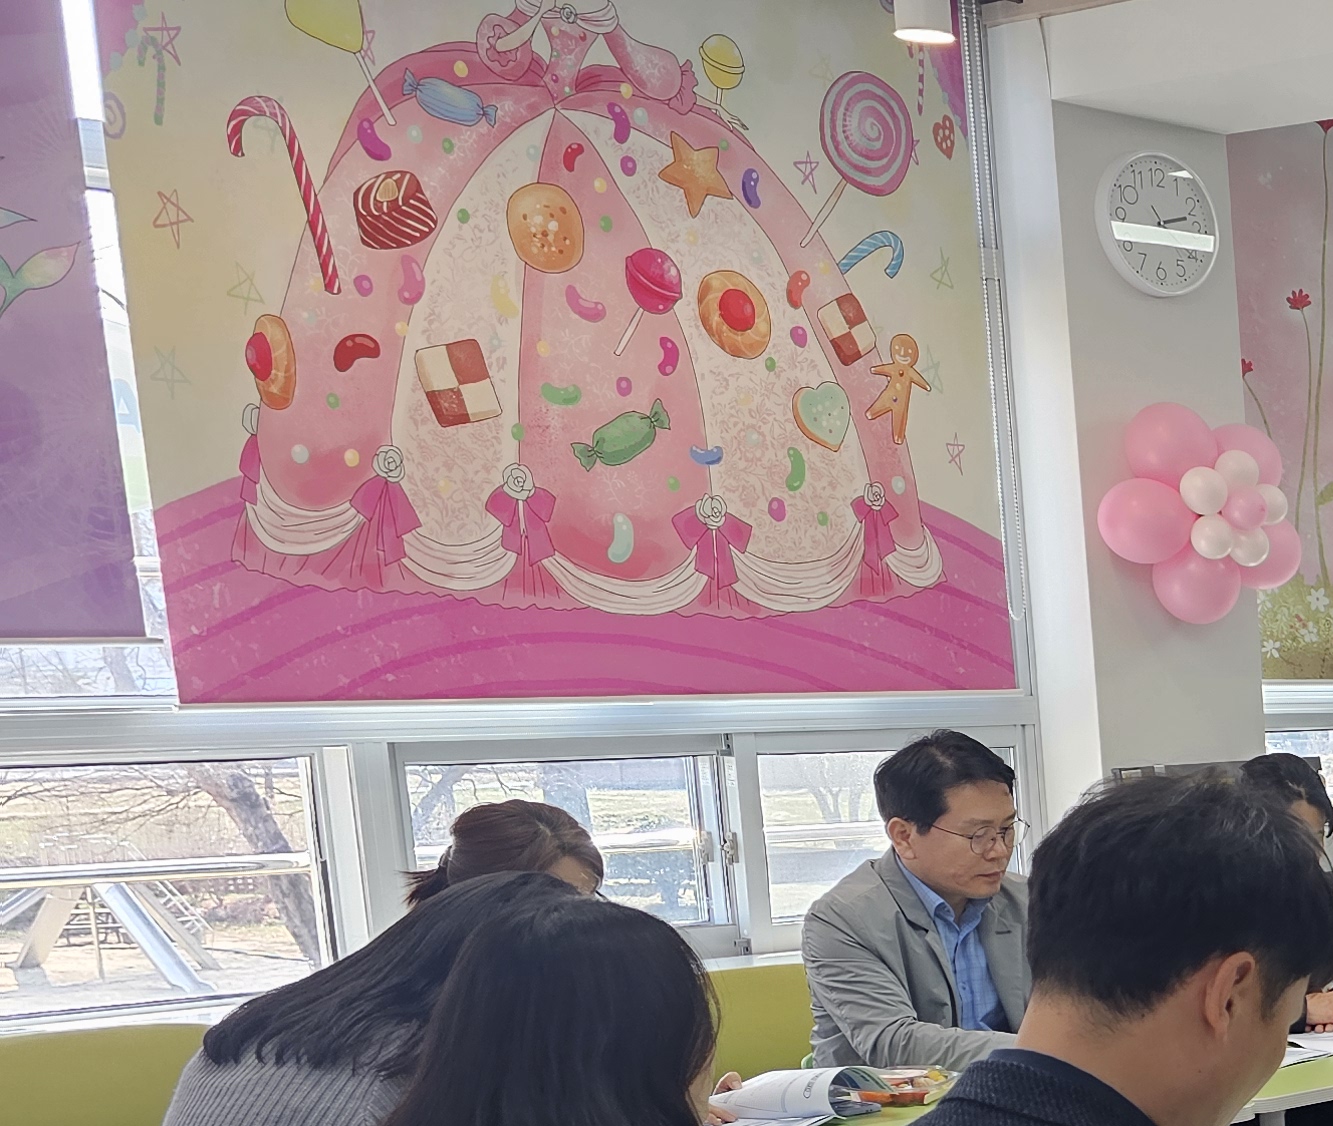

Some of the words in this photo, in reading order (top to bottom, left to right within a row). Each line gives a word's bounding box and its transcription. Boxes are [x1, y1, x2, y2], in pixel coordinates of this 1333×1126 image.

[1131, 169, 1143, 189] 11
[1148, 168, 1165, 188] 12
[1174, 178, 1178, 196] 1
[1118, 185, 1138, 205] 10
[1185, 197, 1196, 216] 2
[1138, 252, 1147, 271] 7
[1156, 261, 1167, 280] 6
[1176, 259, 1185, 277] 5
